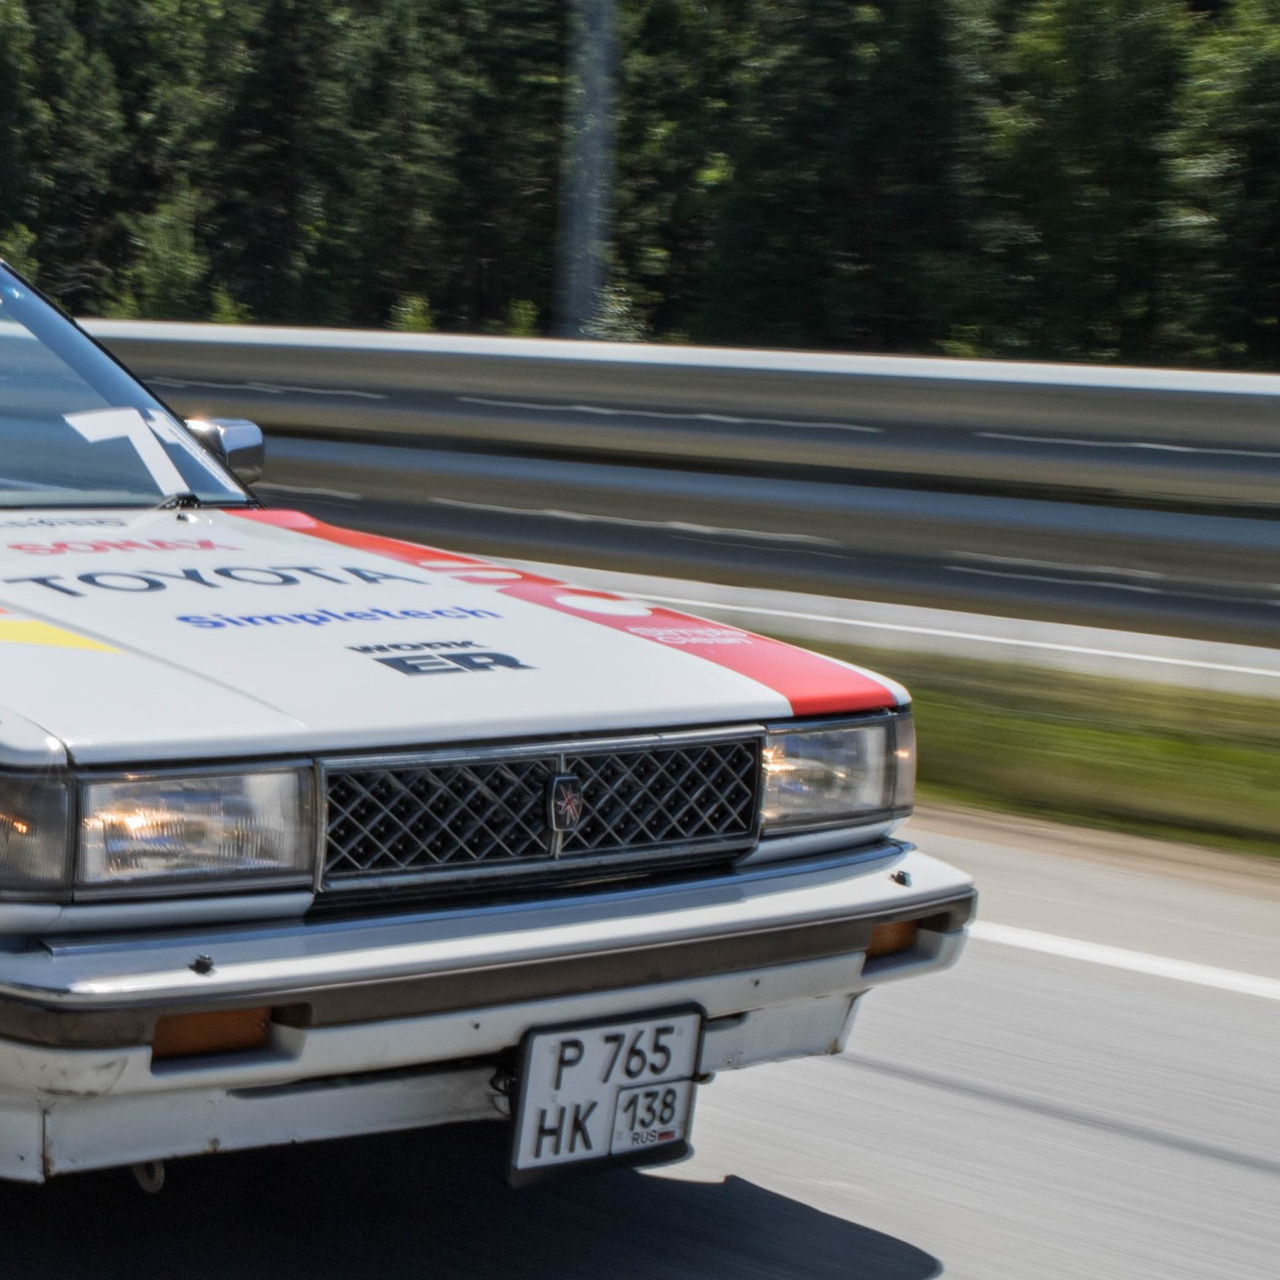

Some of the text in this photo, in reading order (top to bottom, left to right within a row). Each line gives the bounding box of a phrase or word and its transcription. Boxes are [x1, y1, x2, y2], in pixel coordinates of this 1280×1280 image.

[0, 566, 431, 598] TOYOTA
[176, 605, 506, 629] Simpletech
[343, 639, 491, 654] WORK
[555, 1025, 675, 1091] P 765
[623, 1088, 677, 1132] 138
[534, 1101, 599, 1159] HK
[631, 1129, 658, 1146] RUS
